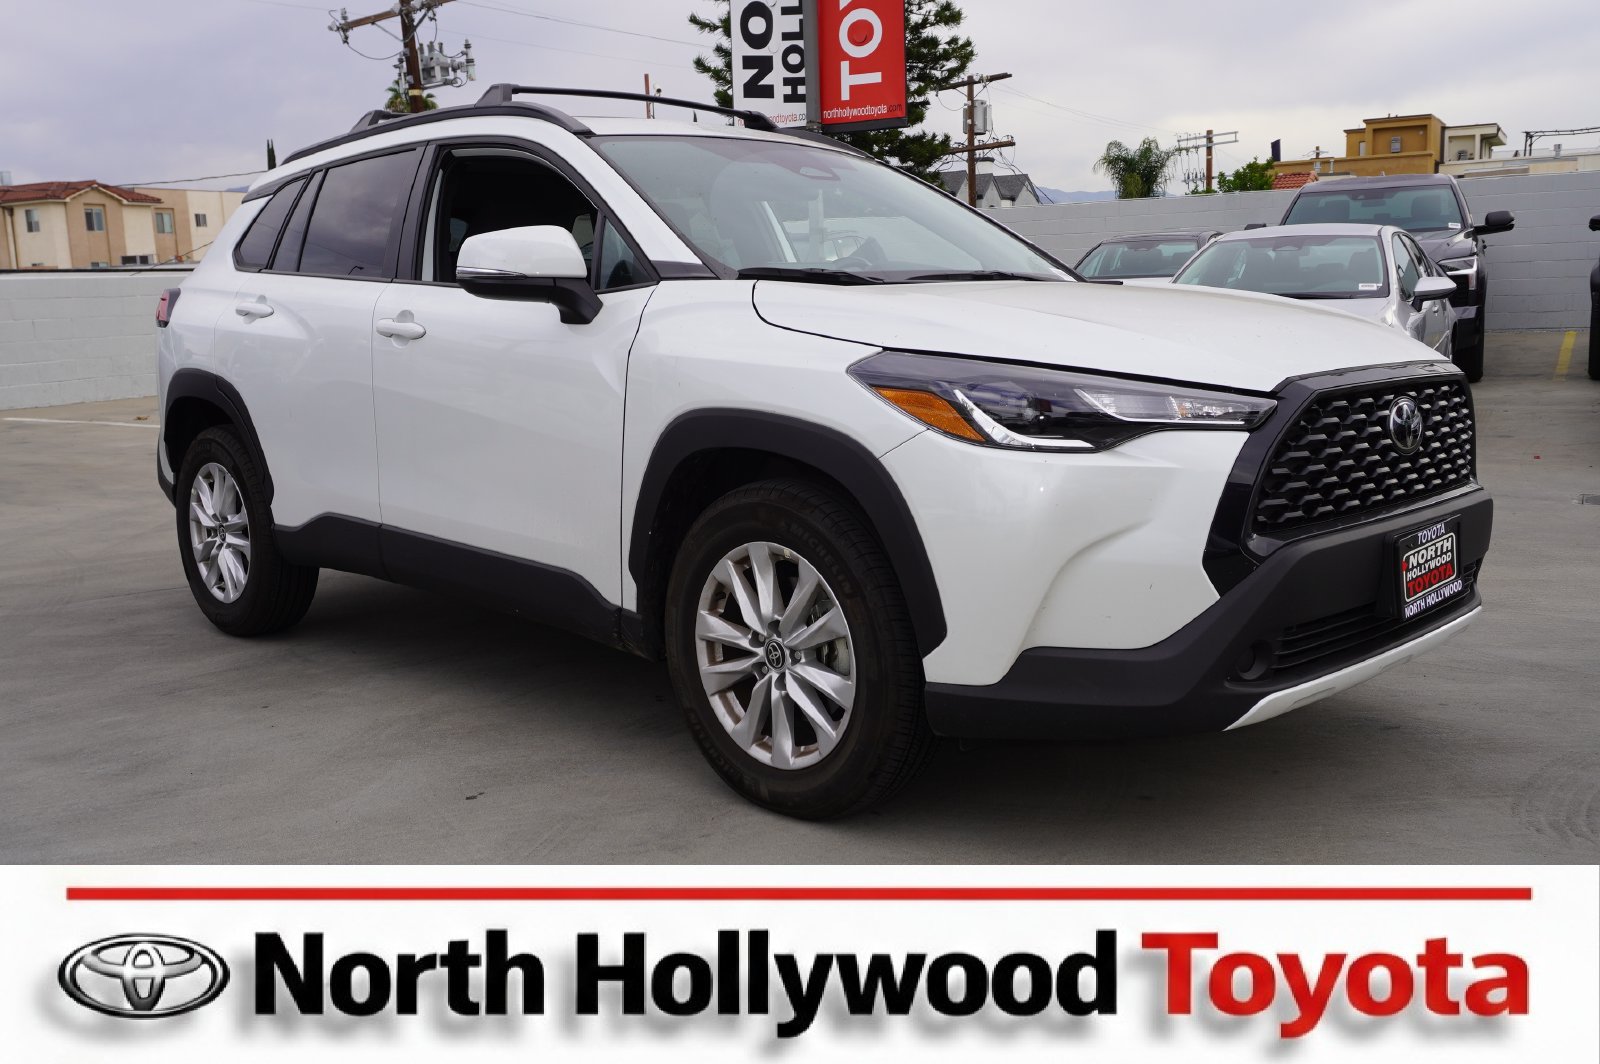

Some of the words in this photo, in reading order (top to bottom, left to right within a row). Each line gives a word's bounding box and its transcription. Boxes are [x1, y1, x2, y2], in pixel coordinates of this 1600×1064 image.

[839, 0, 883, 100] TO
[823, 104, 903, 119] northhollywoodtoyota.com
[1418, 523, 1445, 545] TOYOTA
[1407, 551, 1452, 582] HOLLYWOOD
[1408, 537, 1452, 569] NORTH
[1407, 563, 1453, 597] TOYOTA
[1405, 600, 1426, 618] NORTH
[1426, 579, 1463, 607] HOLLYWOOD
